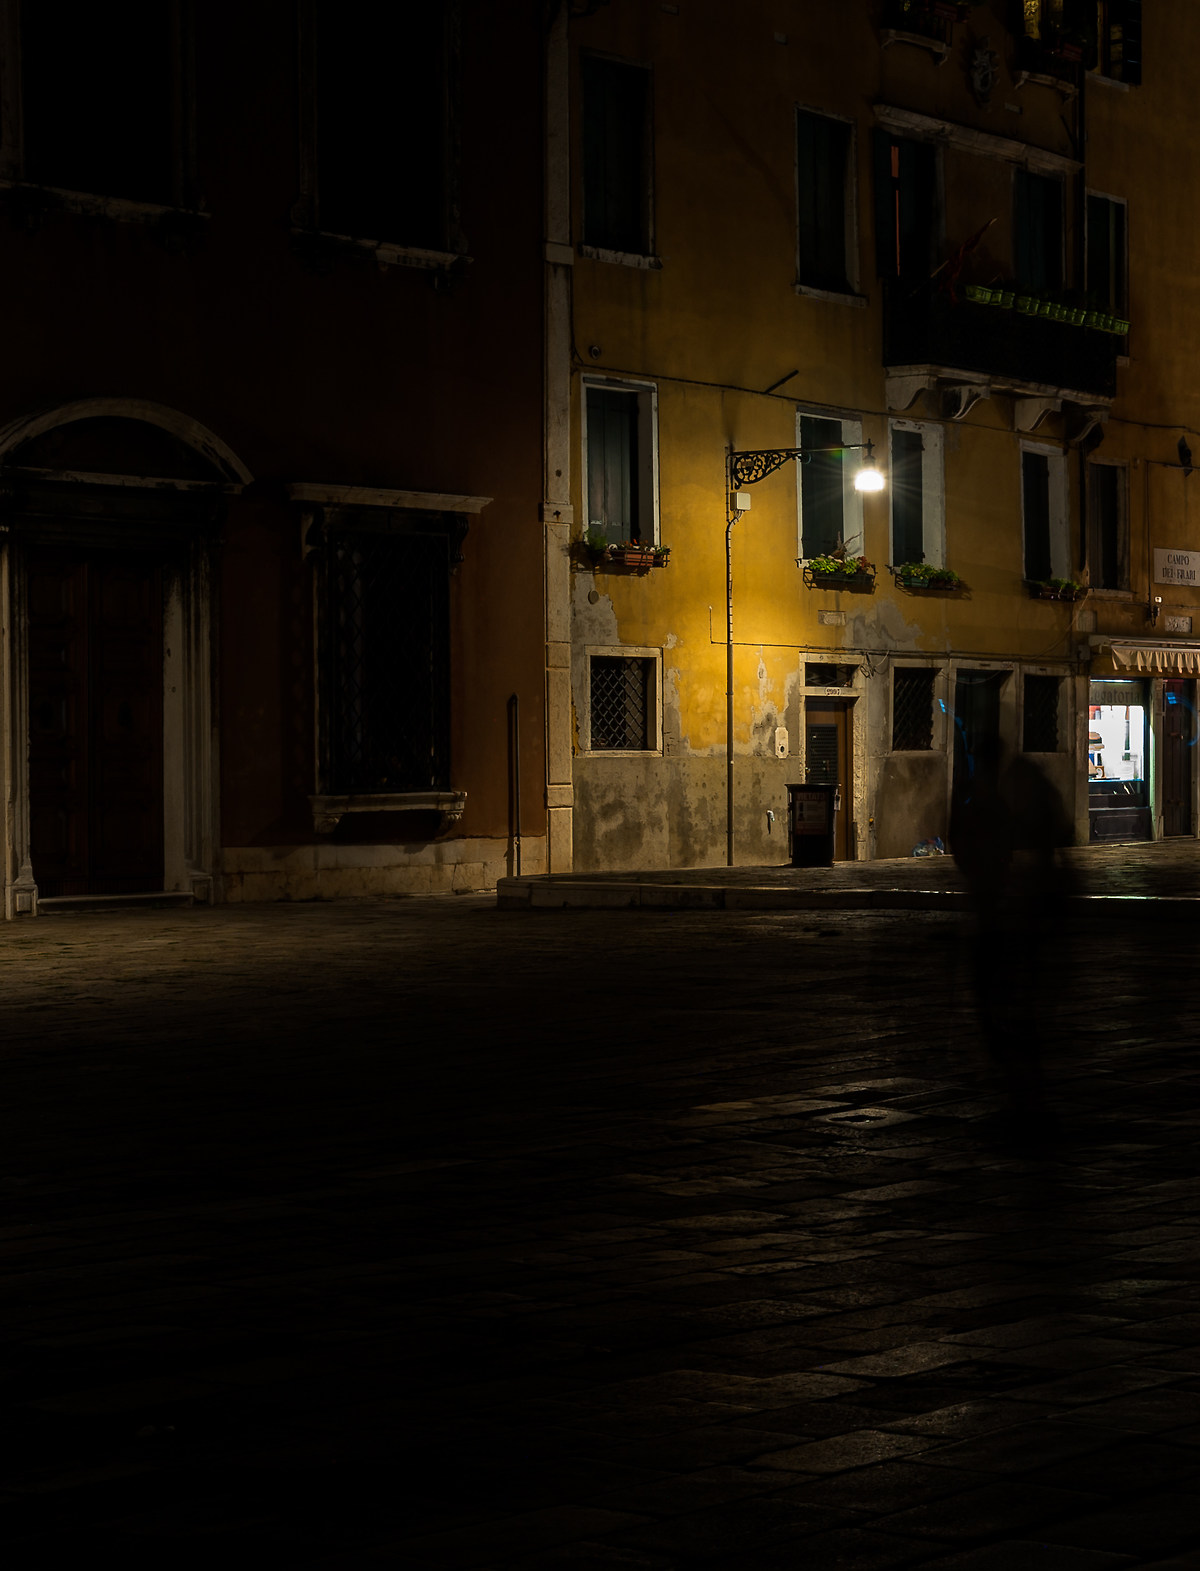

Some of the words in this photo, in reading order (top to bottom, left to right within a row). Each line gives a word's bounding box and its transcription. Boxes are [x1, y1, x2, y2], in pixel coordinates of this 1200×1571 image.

[1167, 554, 1190, 566] CAMPO
[1162, 567, 1174, 578] DEI
[1176, 569, 1196, 580] FRARI
